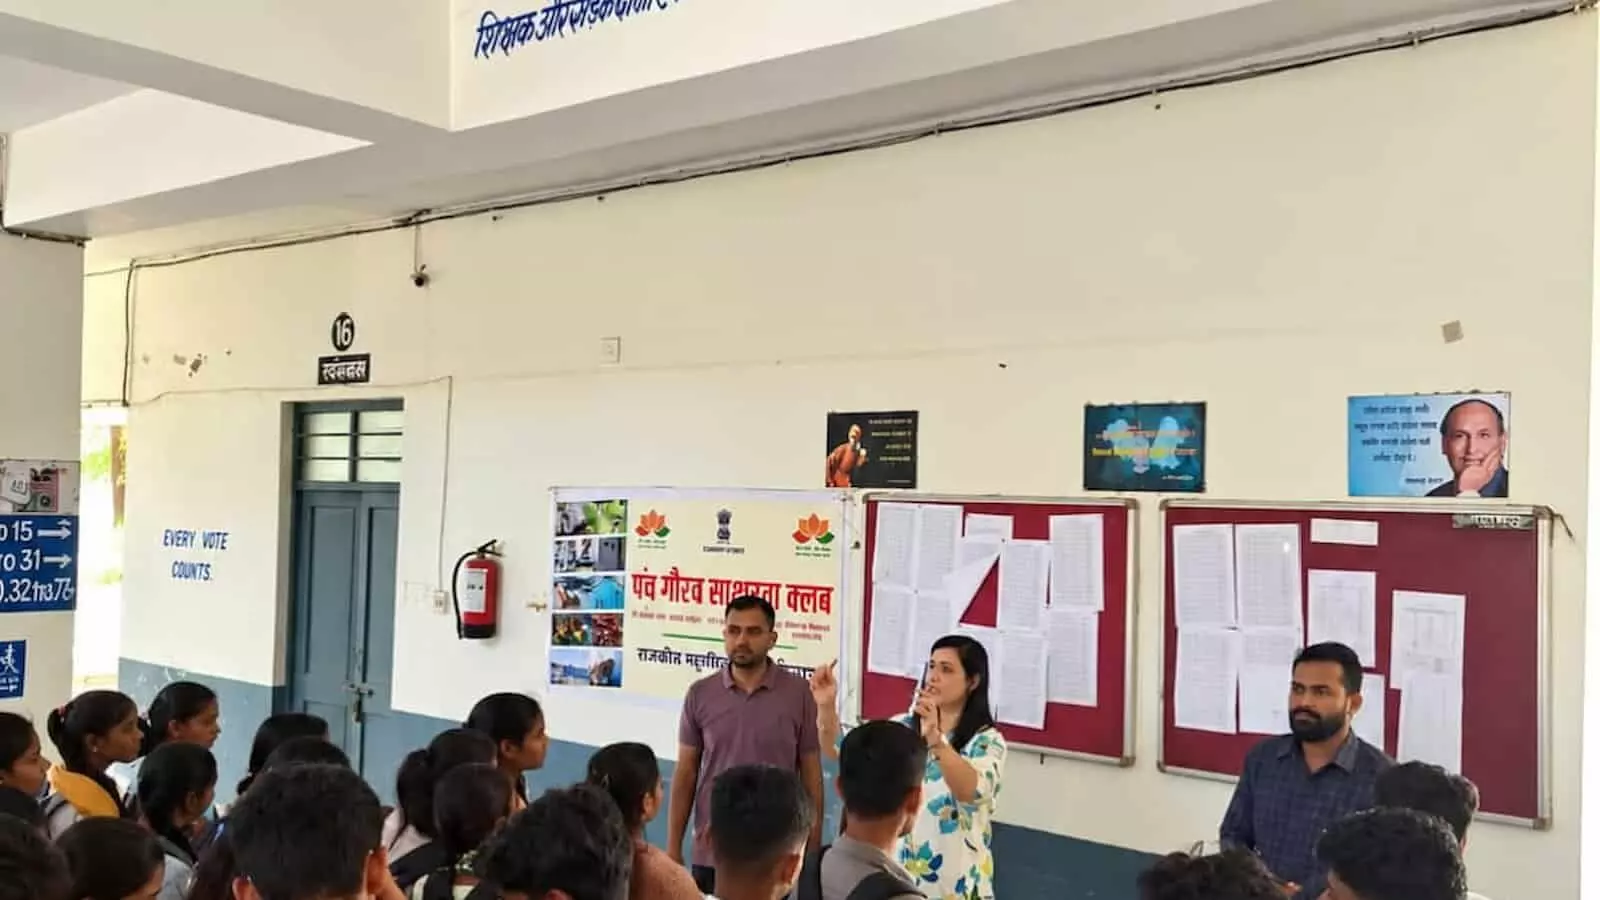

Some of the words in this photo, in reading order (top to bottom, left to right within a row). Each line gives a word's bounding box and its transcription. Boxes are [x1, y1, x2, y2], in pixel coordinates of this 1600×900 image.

[474, 10, 538, 59] शिक्षक
[336, 319, 352, 346] 16
[12, 519, 34, 542] 15
[163, 528, 197, 548] EVERY
[202, 530, 230, 550] VOTE
[19, 548, 41, 572] 31
[660, 566, 706, 605] गौरव
[784, 583, 835, 616] क्लब
